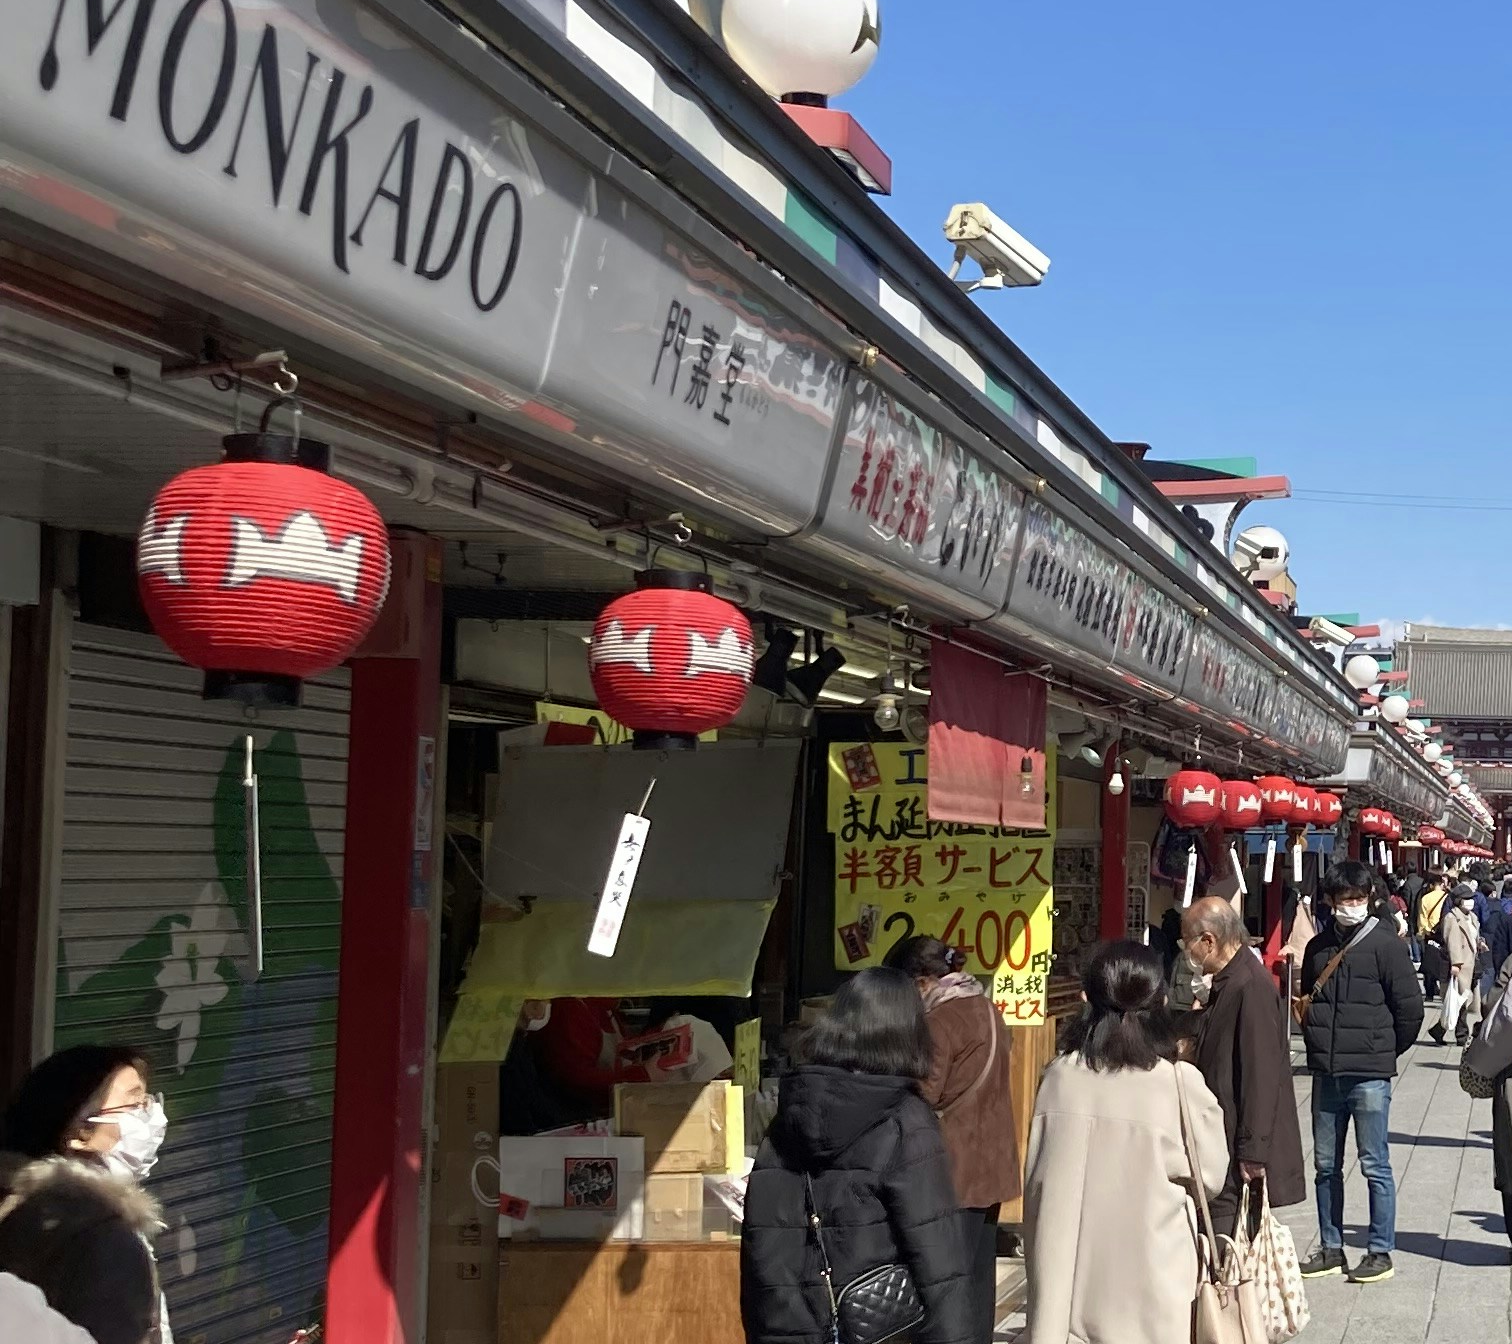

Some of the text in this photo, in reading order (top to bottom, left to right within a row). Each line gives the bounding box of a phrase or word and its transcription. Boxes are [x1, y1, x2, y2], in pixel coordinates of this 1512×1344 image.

[652, 299, 746, 425] 門嘉堂
[838, 843, 1050, 894] 半額サービス
